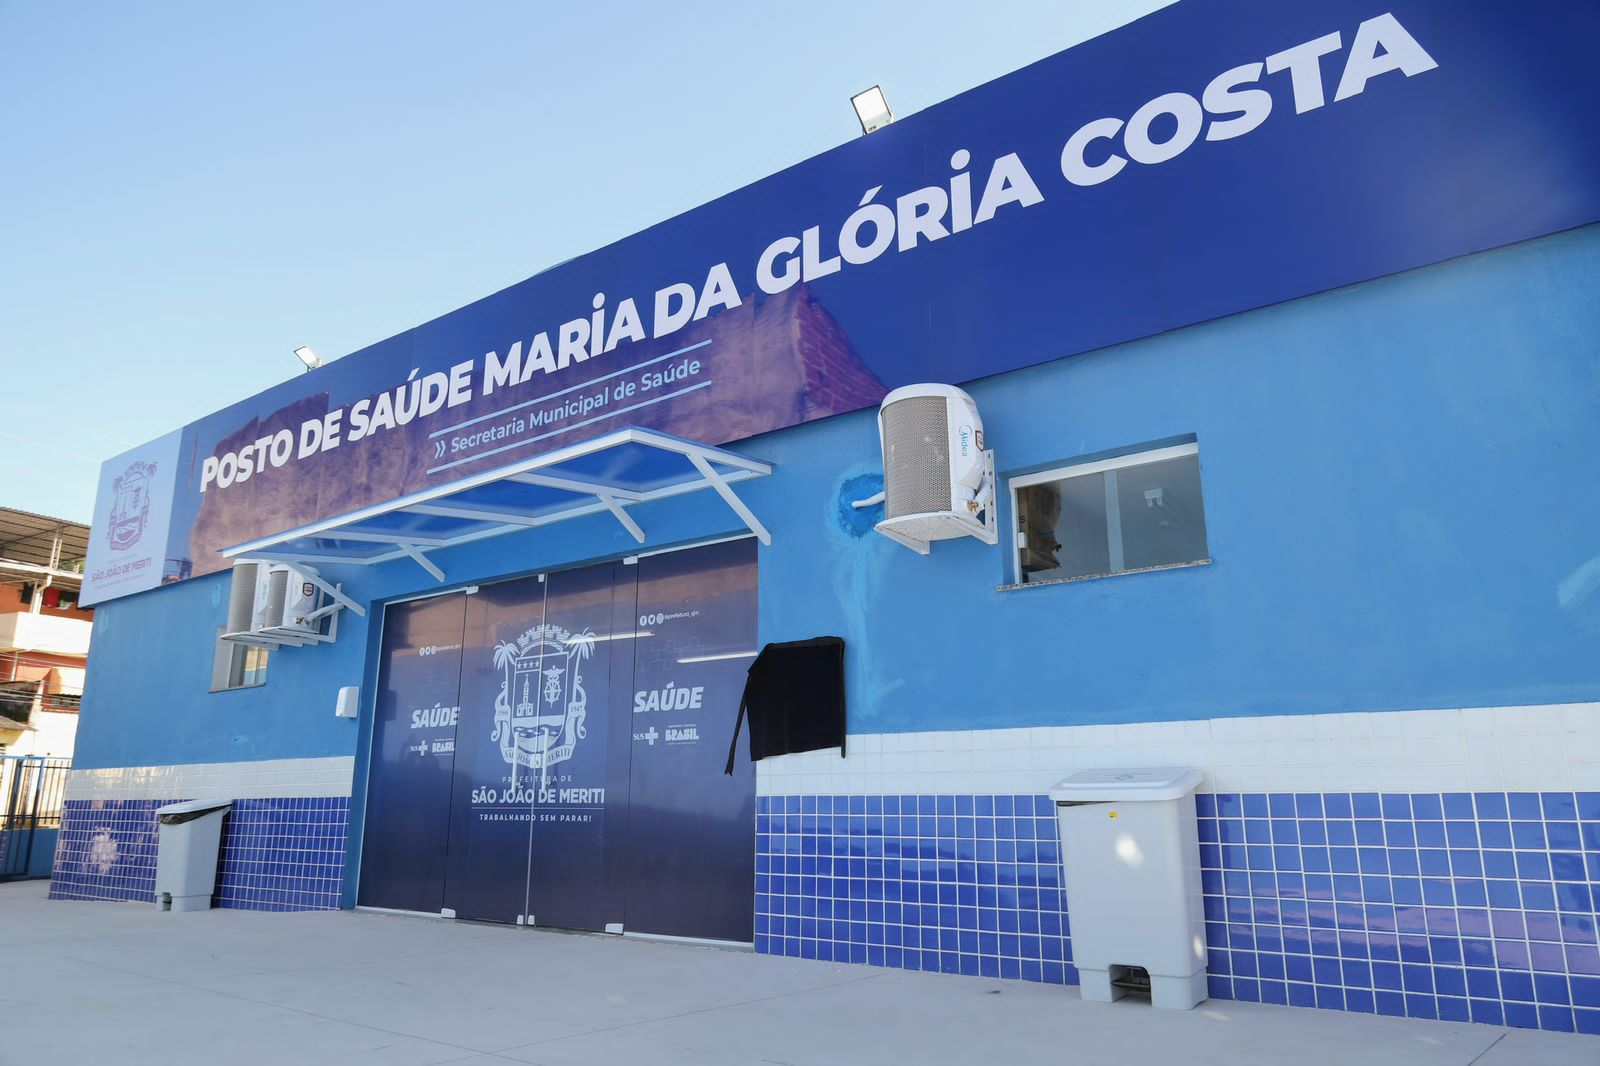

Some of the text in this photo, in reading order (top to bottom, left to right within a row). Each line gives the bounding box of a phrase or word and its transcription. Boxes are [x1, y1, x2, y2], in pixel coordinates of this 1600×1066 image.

[200, 427, 293, 493] POSTO
[297, 413, 343, 460] DE
[347, 359, 474, 443] SAÚDE
[653, 262, 743, 339] DA
[1060, 12, 1439, 187] COSTA
[451, 356, 701, 452] Secretaria Municipal de Saúde
[633, 680, 705, 713] SAÚDE
[411, 702, 460, 728] SAÚDE
[665, 728, 700, 742] BRASIL
[560, 775, 573, 783] DE
[471, 786, 606, 804] SÃO JOÃO DE MERITI
[479, 813, 537, 822] TRABALHANDO
[540, 814, 557, 822] SEM
